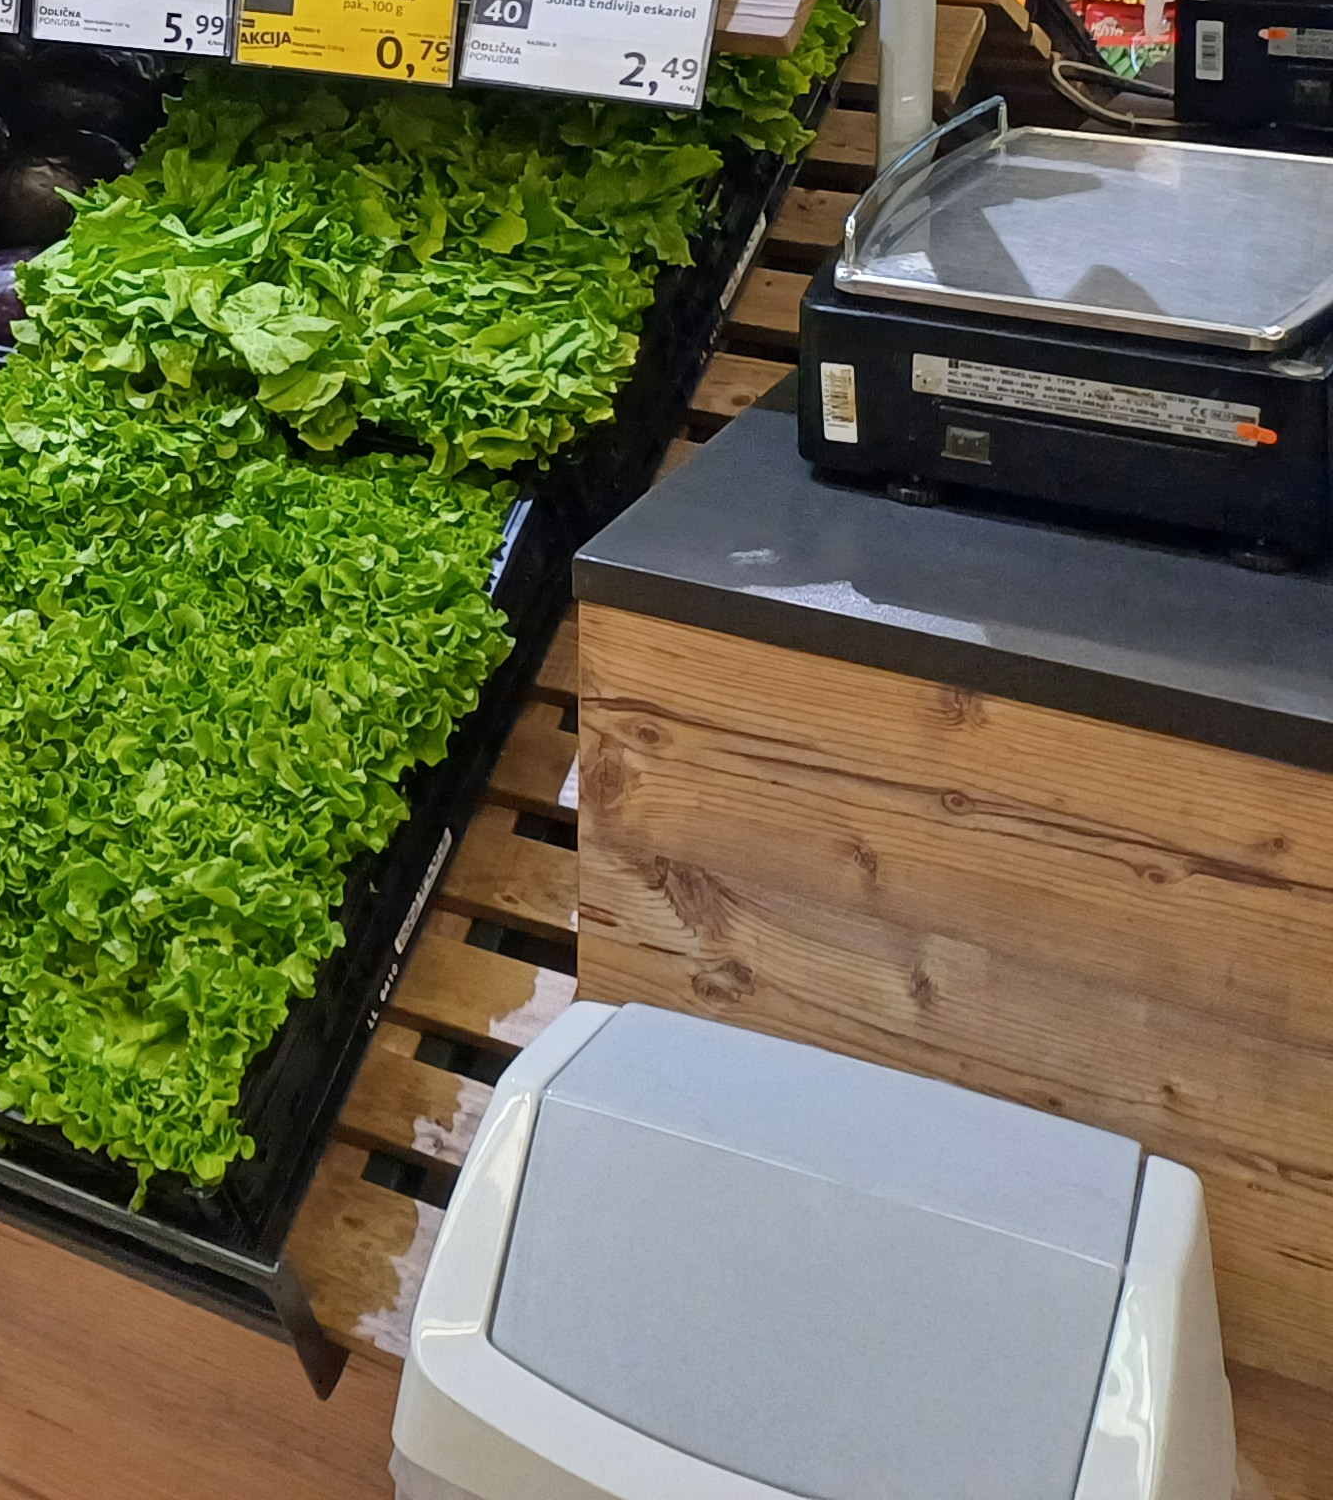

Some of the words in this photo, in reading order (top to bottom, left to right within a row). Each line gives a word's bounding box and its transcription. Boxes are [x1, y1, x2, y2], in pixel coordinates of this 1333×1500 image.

[39, 6, 82, 19] ODLIČNA
[372, 1, 393, 13] 100
[396, 5, 403, 17] g
[483, 0, 522, 24] 40
[643, 2, 697, 19] eskariol
[39, 17, 81, 28] PONUDBA
[163, 12, 225, 51] 5,99
[240, 31, 292, 48] AKCIJA
[470, 40, 522, 55] ODLIČNA
[376, 35, 450, 78] 0,79
[469, 51, 520, 66] PONUDBA
[619, 51, 699, 96] 2,49
